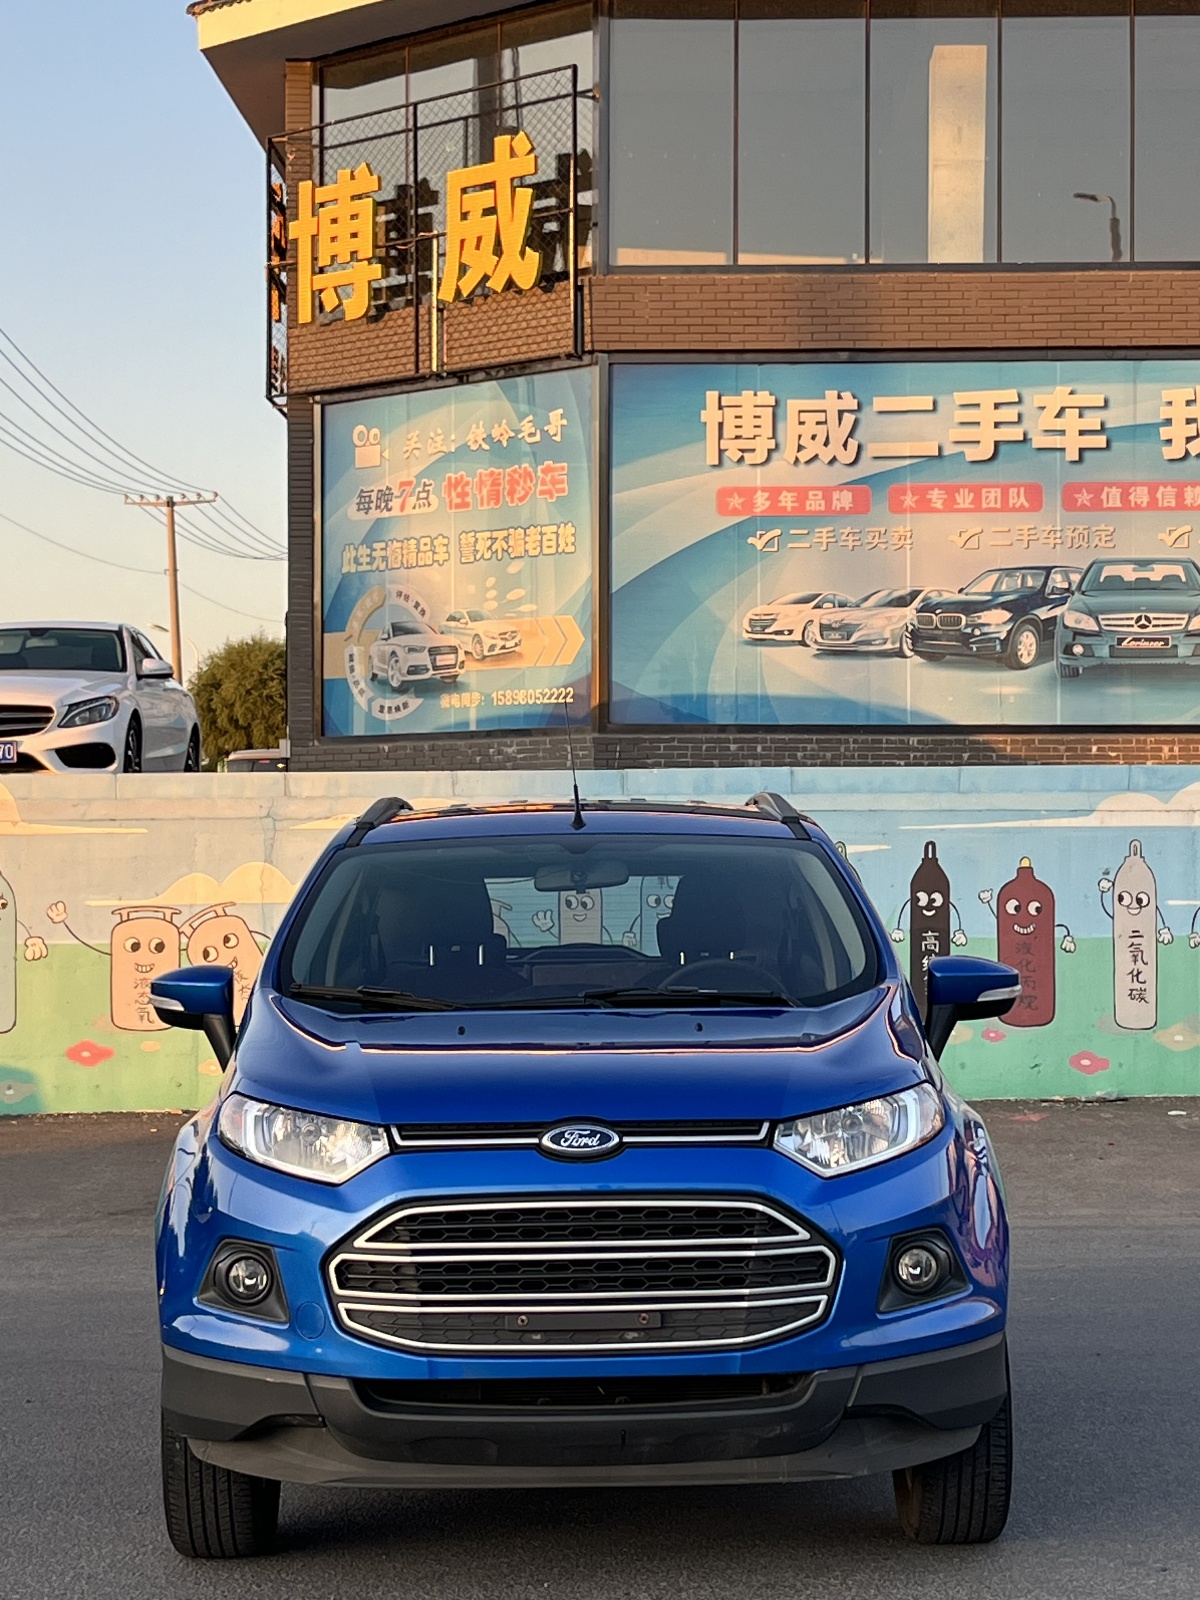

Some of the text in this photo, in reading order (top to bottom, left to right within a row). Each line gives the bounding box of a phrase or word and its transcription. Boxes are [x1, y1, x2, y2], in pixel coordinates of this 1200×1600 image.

[289, 130, 540, 324] 博威
[701, 386, 1107, 466] 博威二手车
[355, 479, 434, 515] 每晚7点
[753, 488, 854, 512] 多年品牌
[926, 486, 1030, 510] 专业团队
[1101, 485, 1200, 509] 值得信赖
[341, 521, 576, 574] 此生无悔精品车 誓死不骗老百姓
[787, 526, 914, 552] 二手车买卖
[989, 525, 1117, 550] 二手车预定
[491, 687, 574, 707] 15898052222
[1126, 930, 1150, 1005] 二氧化碳
[560, 1129, 601, 1147] Ford
